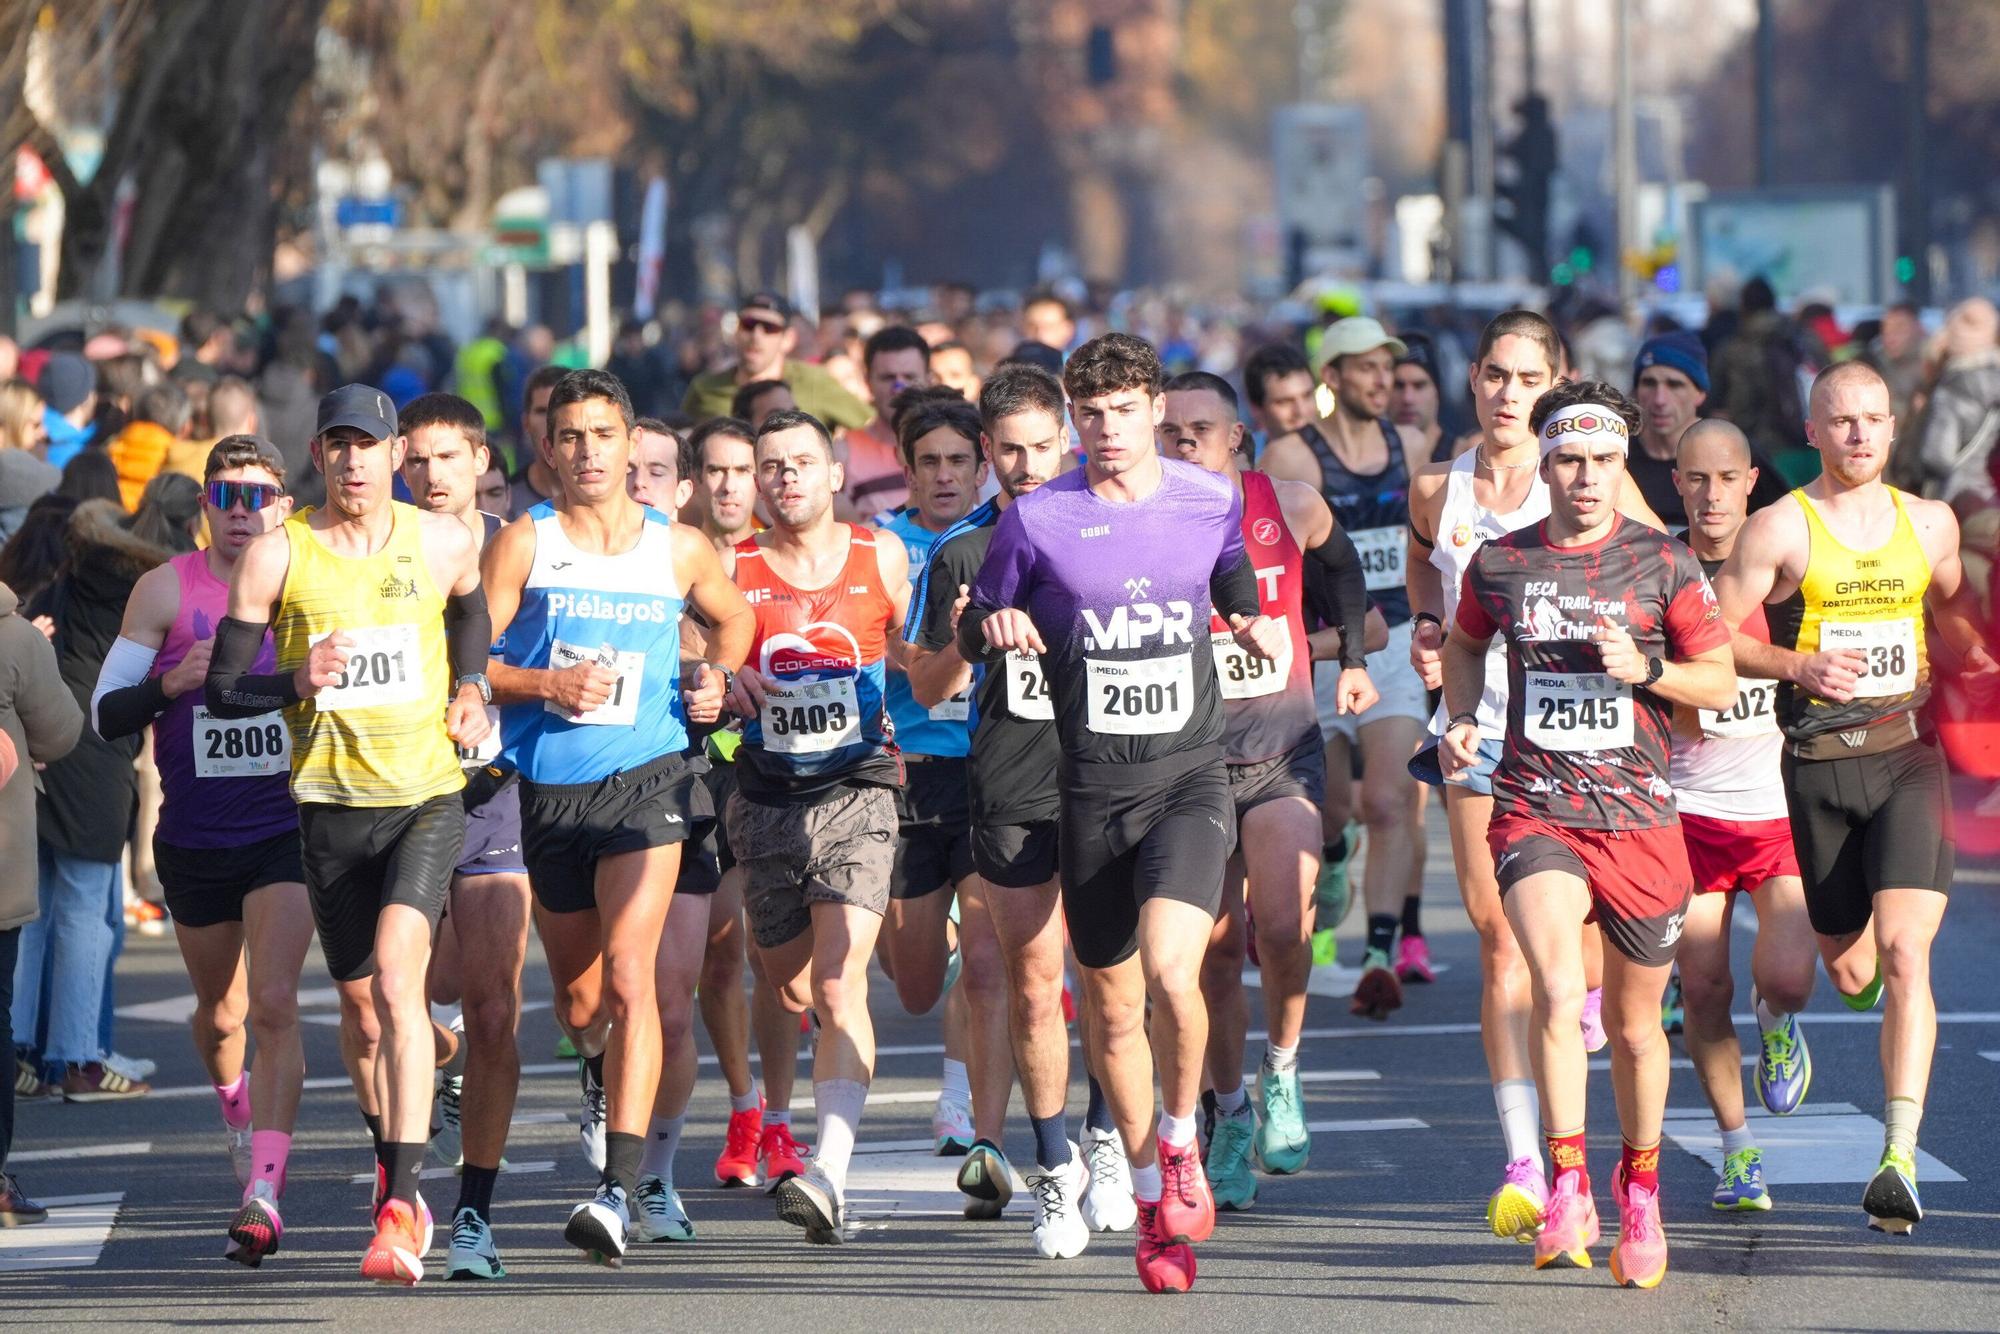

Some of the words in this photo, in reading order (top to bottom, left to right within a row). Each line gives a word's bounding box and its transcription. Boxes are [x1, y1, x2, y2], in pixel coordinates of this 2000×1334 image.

[1545, 411, 1629, 440] CROWN
[1080, 524, 1111, 538] GOBIK
[1524, 581, 1558, 597] BECA
[1558, 595, 1593, 610] TRAIL
[1592, 601, 1626, 616] TEAM
[1822, 596, 1896, 608] ZORTZIETAKOAK
[1835, 578, 1905, 595] GAIKAR
[1081, 600, 1194, 651] MPR
[1555, 621, 1627, 640] Chiru
[1103, 680, 1178, 716] 2601
[1538, 697, 1619, 731] 2545
[770, 701, 848, 736] 3403
[204, 723, 284, 759] 2808
